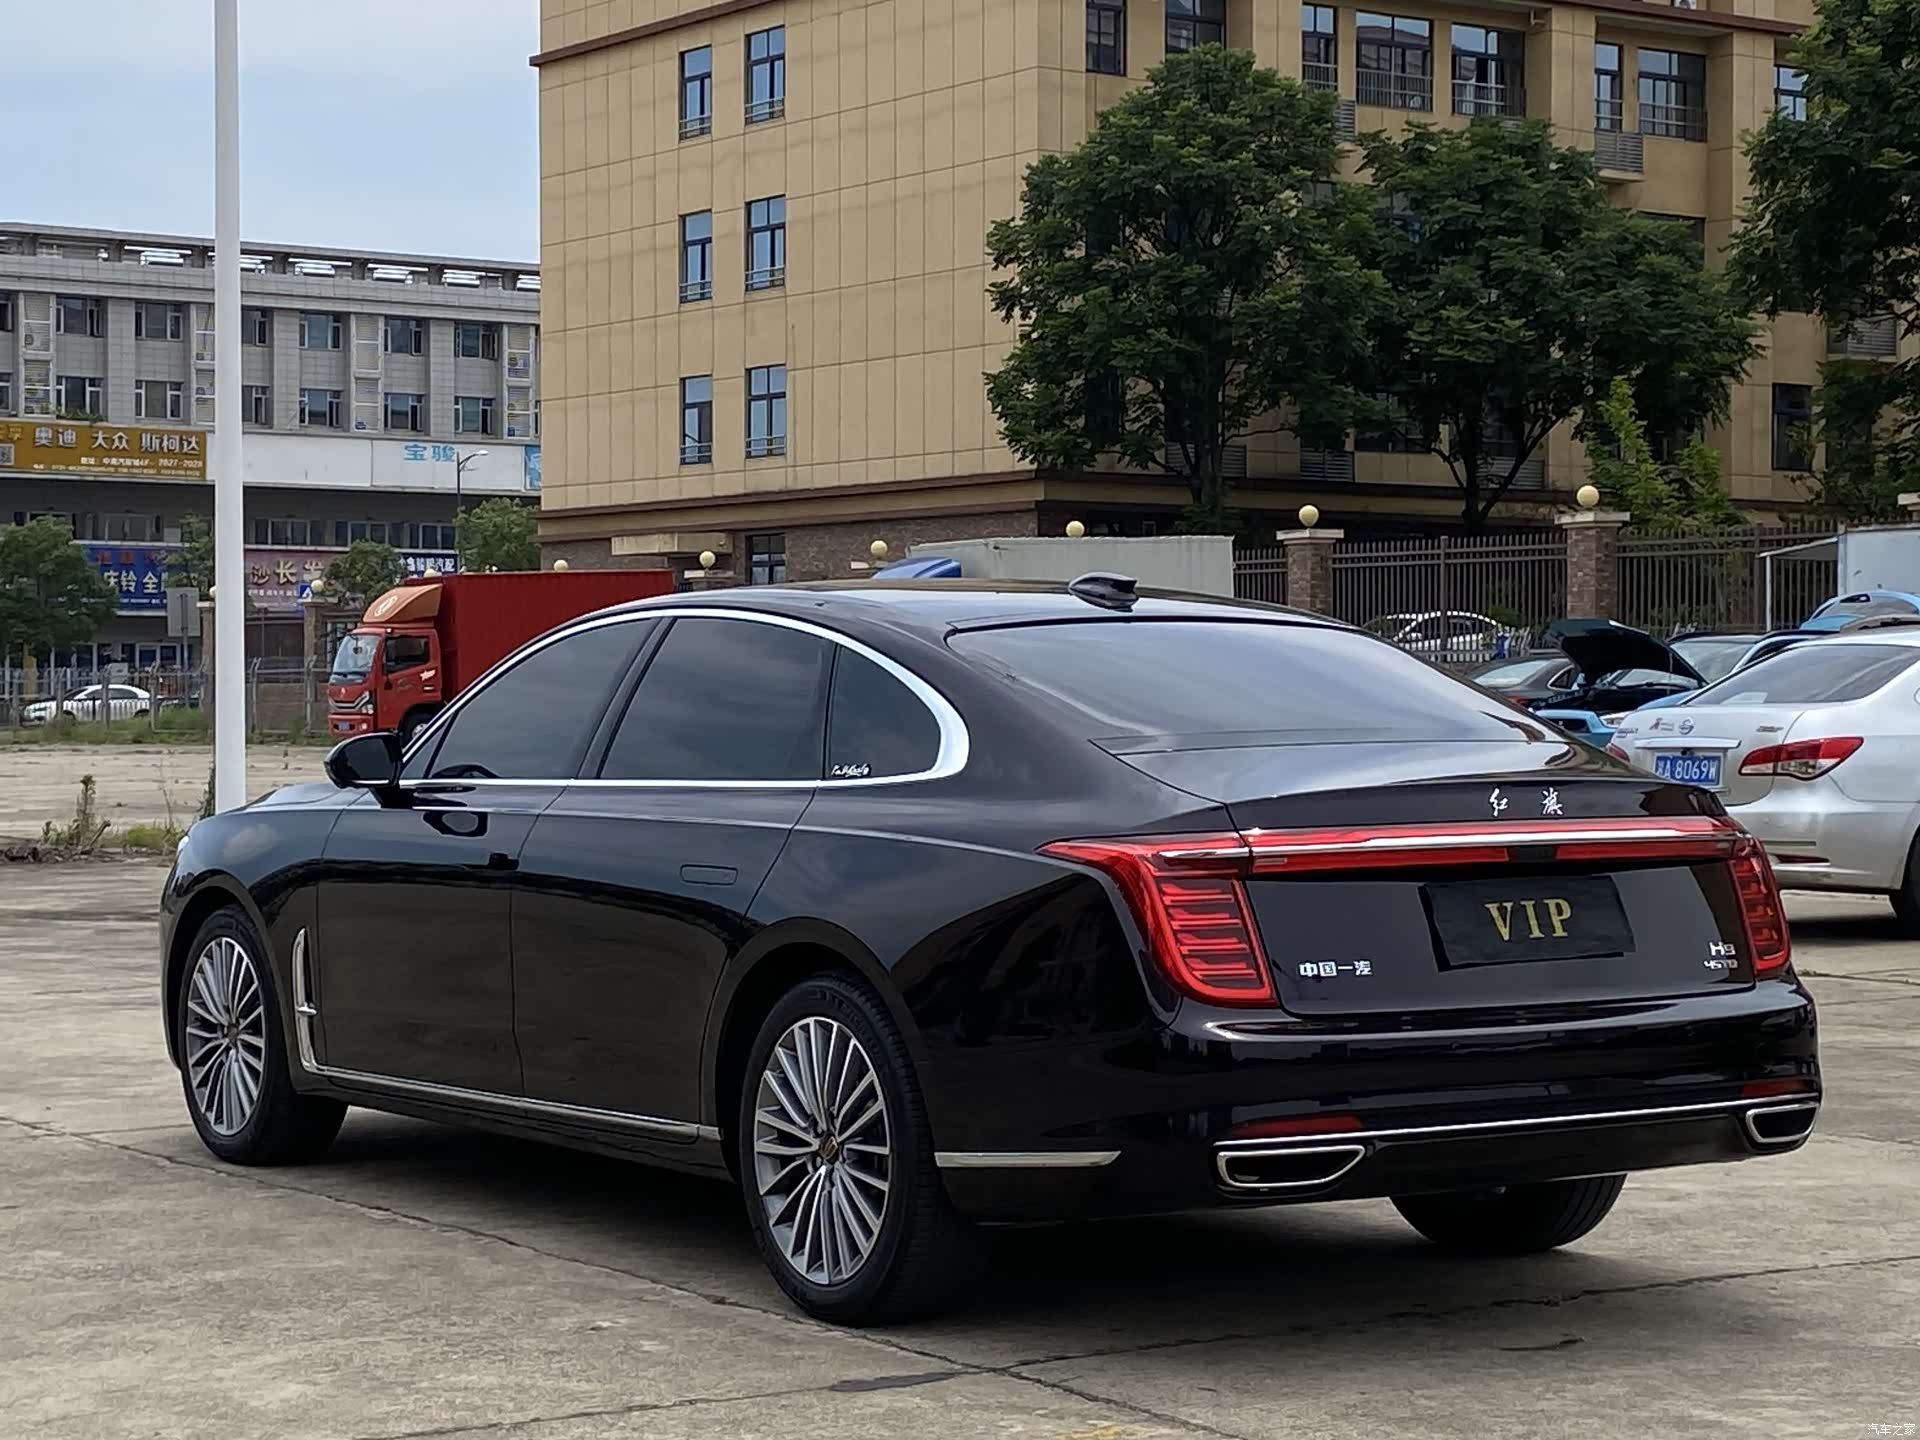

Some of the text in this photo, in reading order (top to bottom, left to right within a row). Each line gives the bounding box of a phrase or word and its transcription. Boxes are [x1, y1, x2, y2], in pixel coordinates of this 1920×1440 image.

[34, 426, 77, 448] 奥迪
[91, 430, 130, 450] 大众
[140, 431, 200, 454] 斯柯达
[403, 443, 456, 462] 宝骏
[1485, 898, 1572, 941] VIP
[1709, 941, 1736, 956] H9
[1299, 960, 1373, 977] 中国一汽
